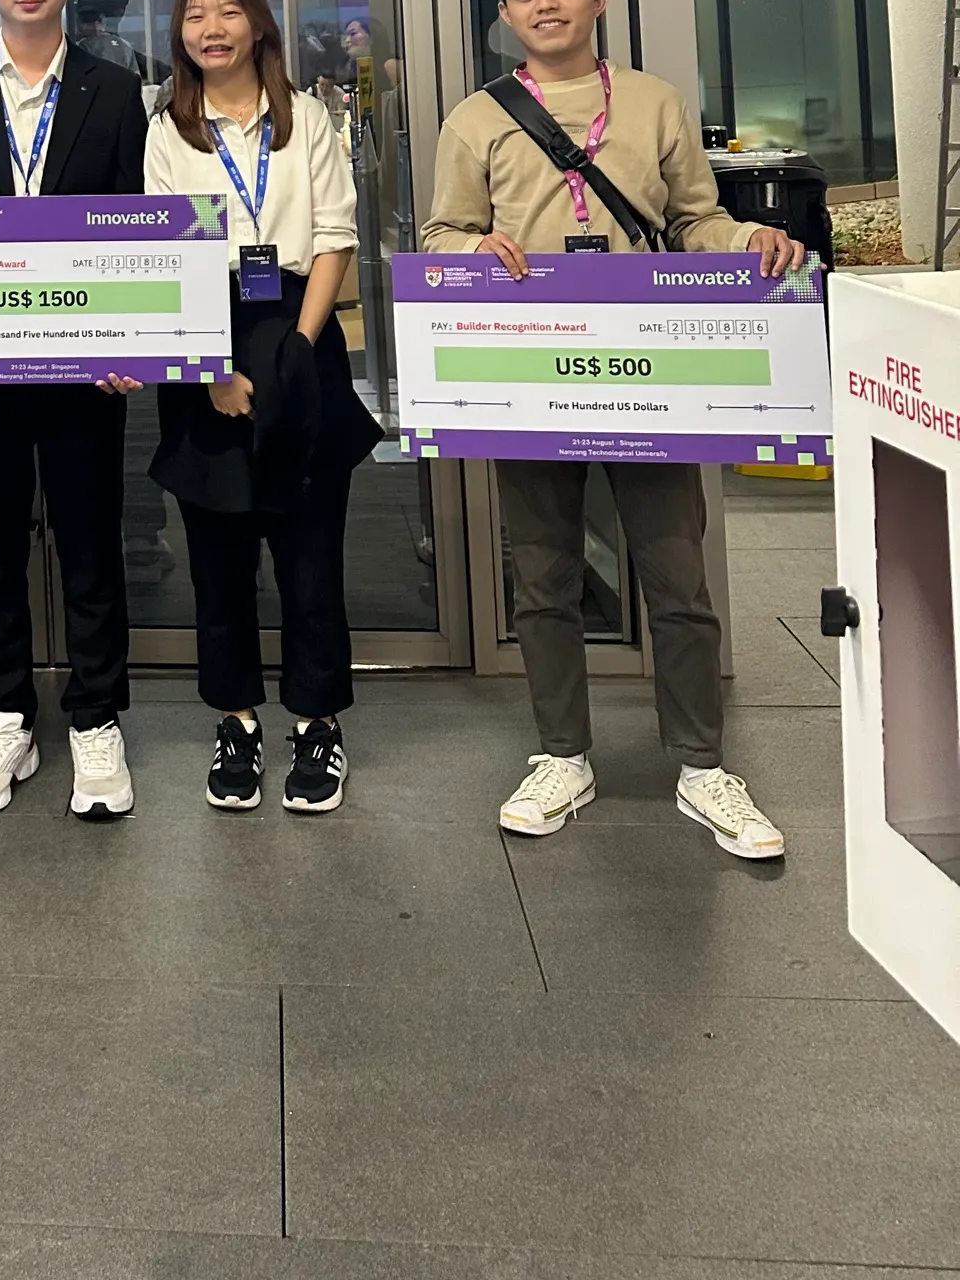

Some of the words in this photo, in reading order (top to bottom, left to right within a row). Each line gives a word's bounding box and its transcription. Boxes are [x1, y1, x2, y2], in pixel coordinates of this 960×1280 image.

[38, 290, 89, 307] 1500
[431, 322, 452, 331] PAY:
[456, 322, 492, 331] Builder
[494, 322, 552, 333] Recognition
[553, 323, 587, 331] Award
[23, 330, 41, 338] Five
[42, 330, 80, 338] Hundred
[81, 330, 93, 338] US
[95, 329, 126, 338] Dollars
[27, 363, 48, 371] August
[50, 363, 80, 371] Singapore
[555, 356, 601, 377] US$
[608, 357, 652, 376] 500
[24, 372, 64, 380] Technological
[64, 371, 93, 380] University
[886, 356, 922, 394] FIRE
[549, 401, 570, 410] Five
[572, 401, 615, 411] Hundred
[617, 402, 631, 411] US
[633, 402, 669, 412] Dollars
[572, 438, 591, 446] 21-23
[591, 439, 615, 447] August
[619, 439, 653, 447] Singapore
[558, 448, 587, 457] Nanyang
[588, 449, 634, 458] Technological
[635, 450, 668, 458] University
